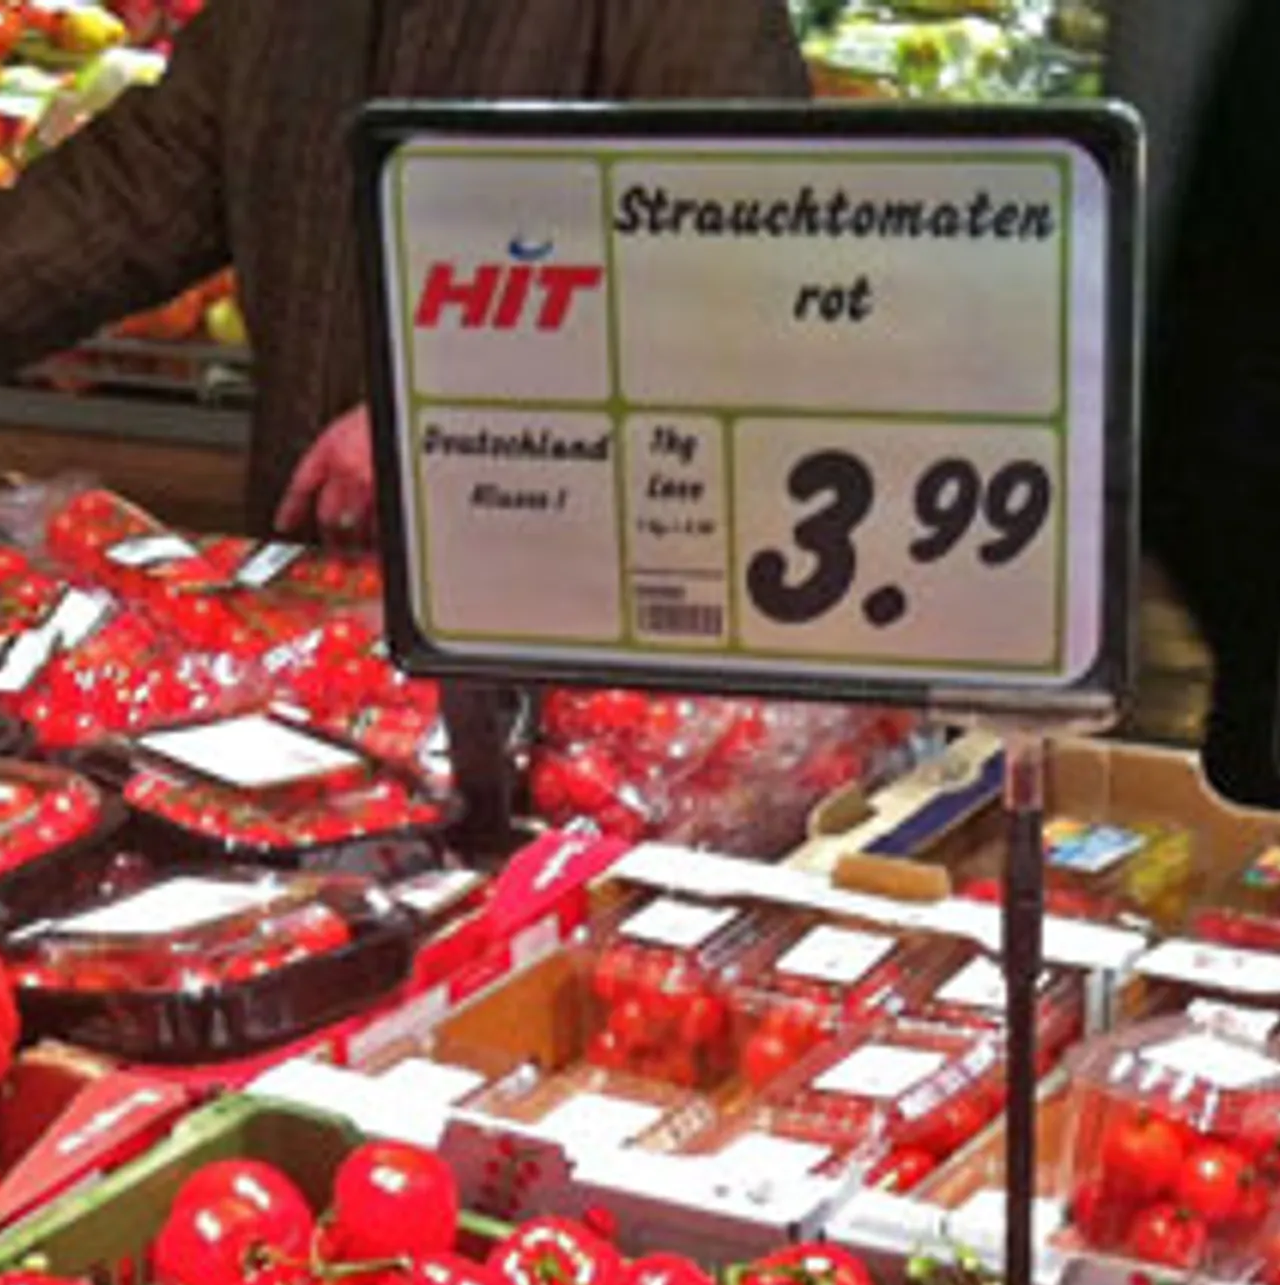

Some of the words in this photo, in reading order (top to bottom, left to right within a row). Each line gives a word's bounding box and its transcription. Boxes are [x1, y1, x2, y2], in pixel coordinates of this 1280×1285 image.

[612, 184, 1056, 241] Strauchtomaten
[415, 263, 603, 332] HIT
[792, 277, 873, 323] rot
[422, 424, 611, 462] Deutschland
[649, 424, 700, 466] 1kg
[746, 448, 1051, 628] 3.99
